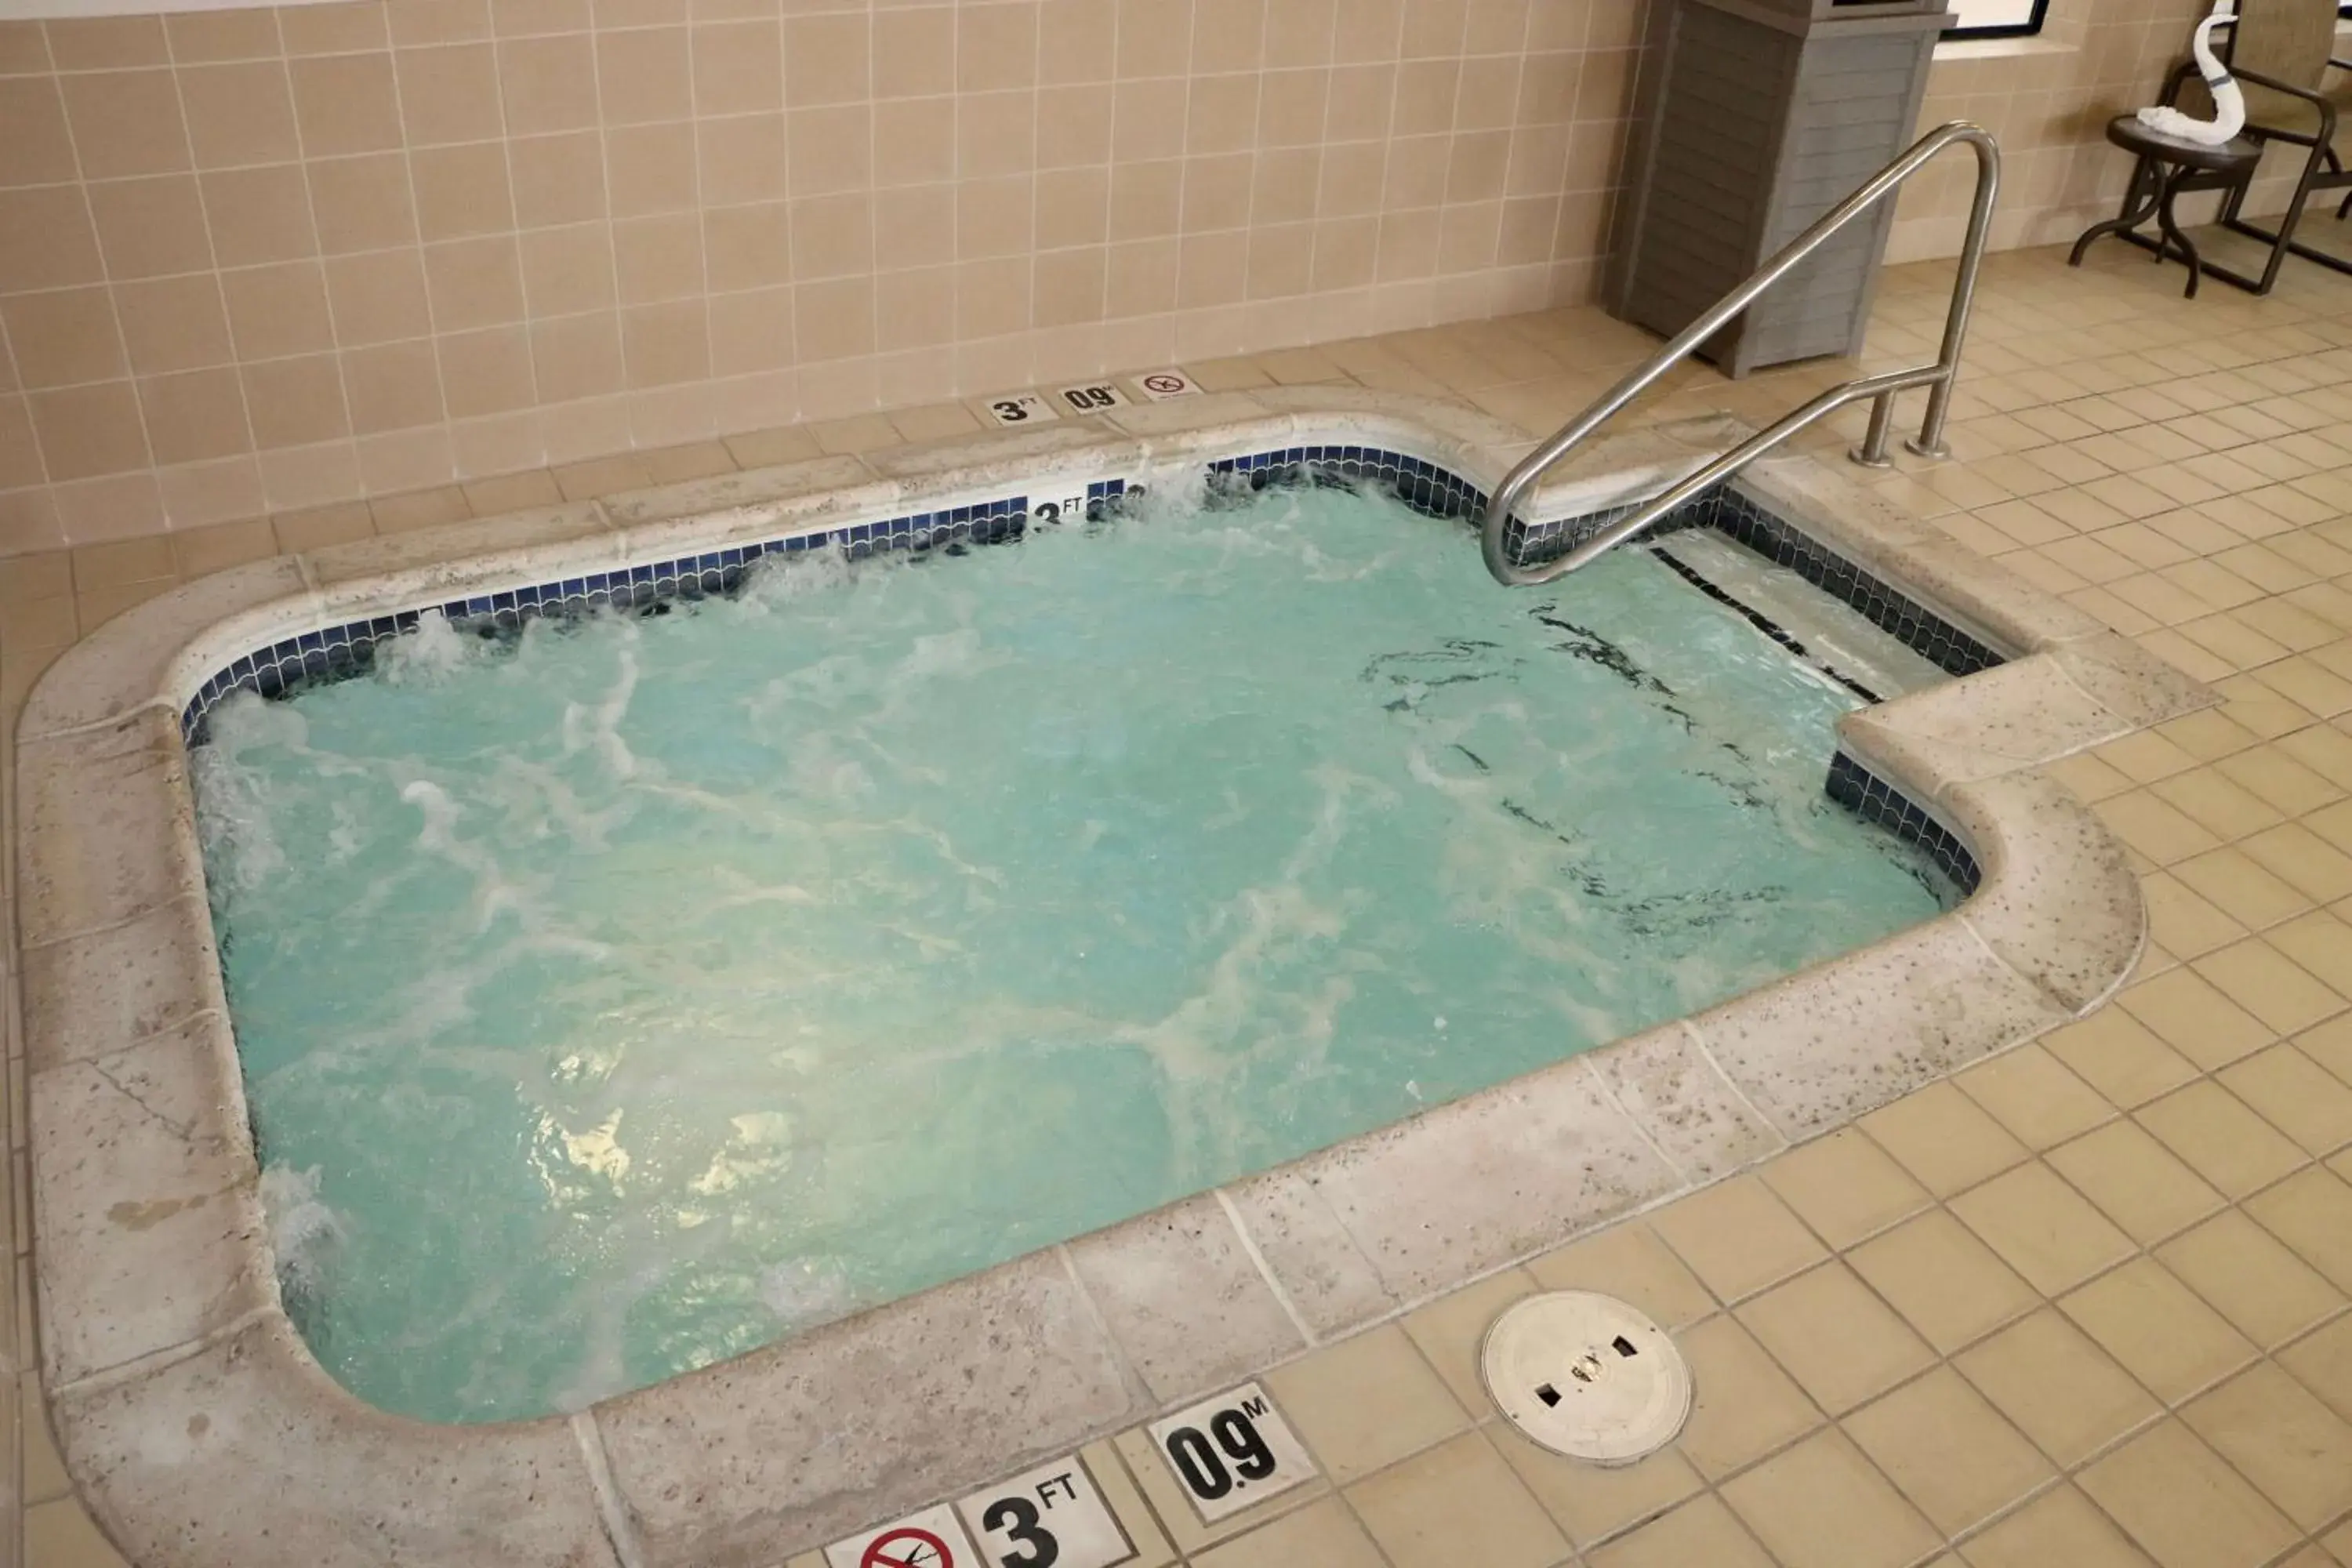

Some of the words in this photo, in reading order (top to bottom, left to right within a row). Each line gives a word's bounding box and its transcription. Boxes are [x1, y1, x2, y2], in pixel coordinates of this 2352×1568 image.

[993, 401, 1028, 421] 3
[1063, 496, 1083, 514] FT
[1166, 1409, 1276, 1500] 0.9
[1241, 1396, 1270, 1420] M
[982, 1497, 1058, 1568] 3
[1035, 1472, 1076, 1509] FT
